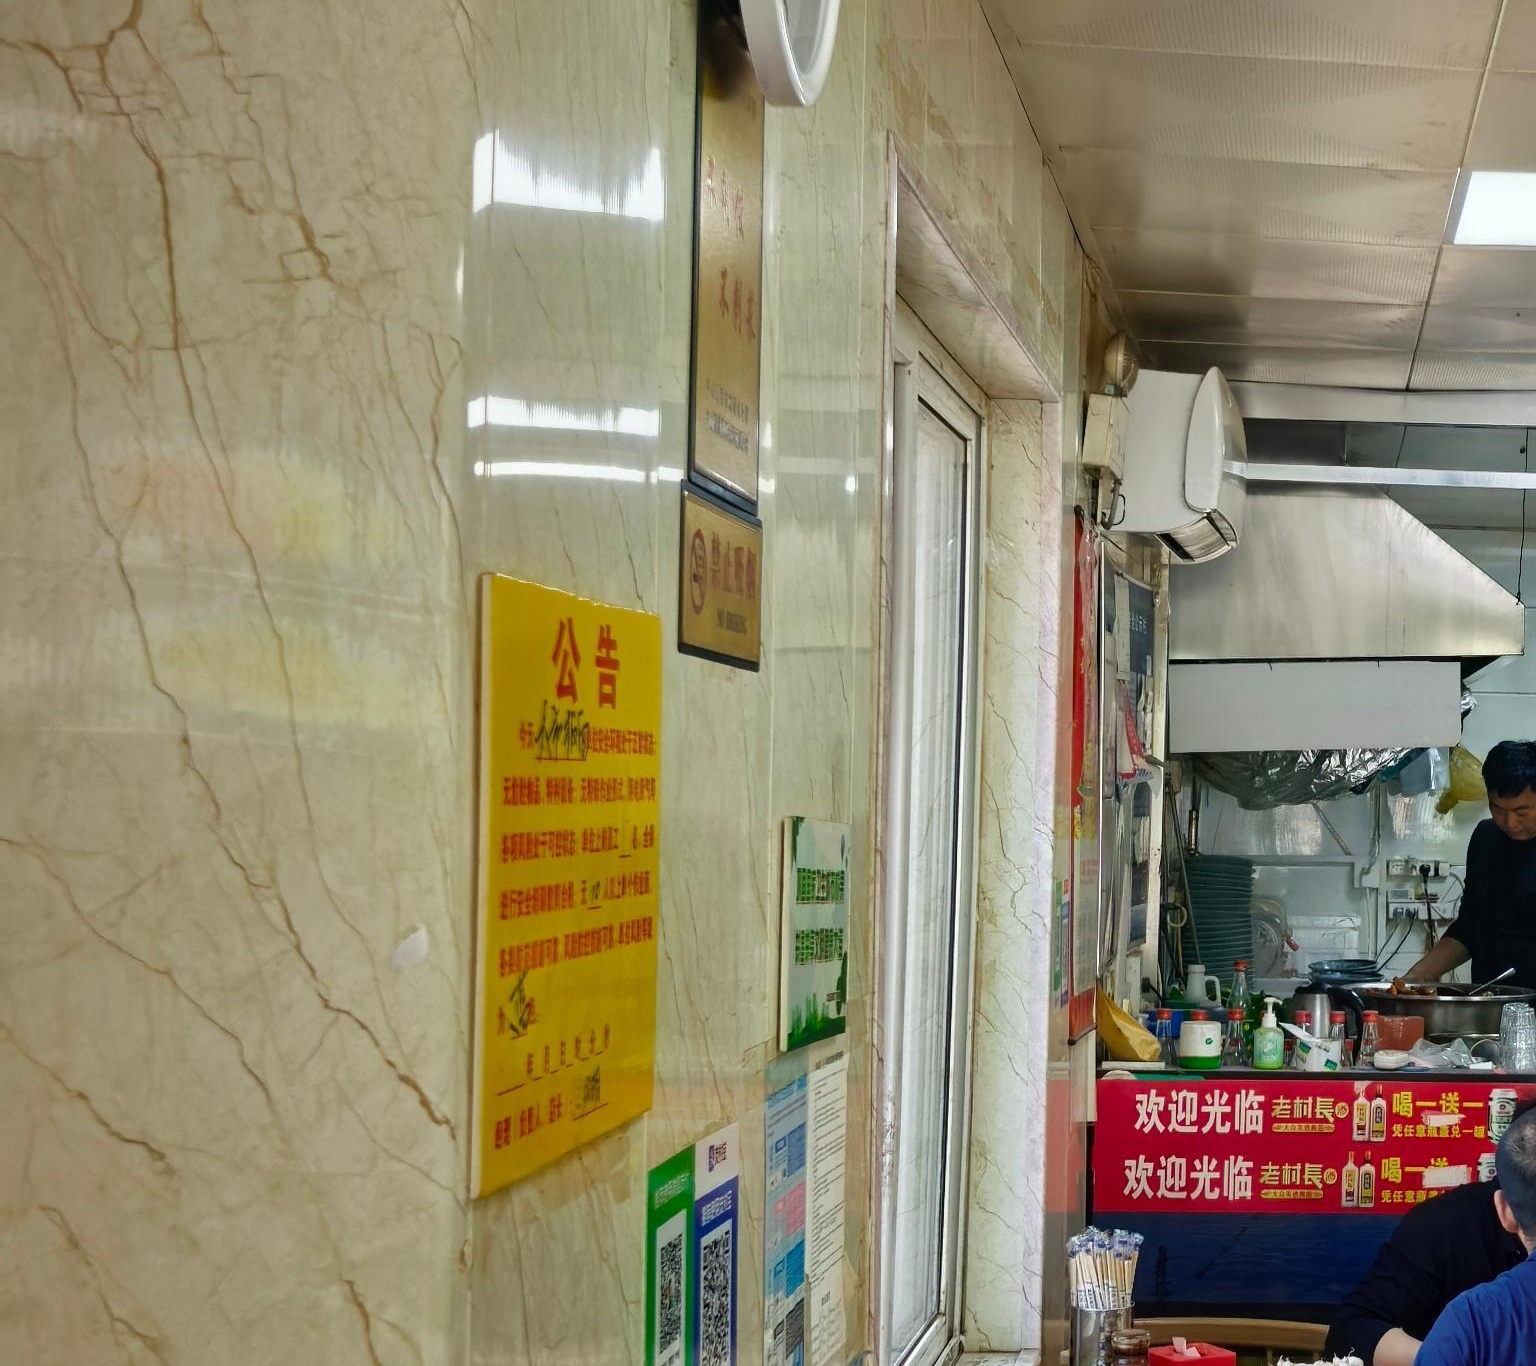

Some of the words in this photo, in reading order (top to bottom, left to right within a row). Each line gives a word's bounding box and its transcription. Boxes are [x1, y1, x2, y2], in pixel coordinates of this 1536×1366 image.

[552, 617, 620, 710] 公告
[1134, 1089, 1265, 1135] 欢迎光临
[1271, 1095, 1336, 1123] 老村長
[1392, 1091, 1484, 1118] 喝一送一
[1123, 1154, 1253, 1200] 欢迎光临
